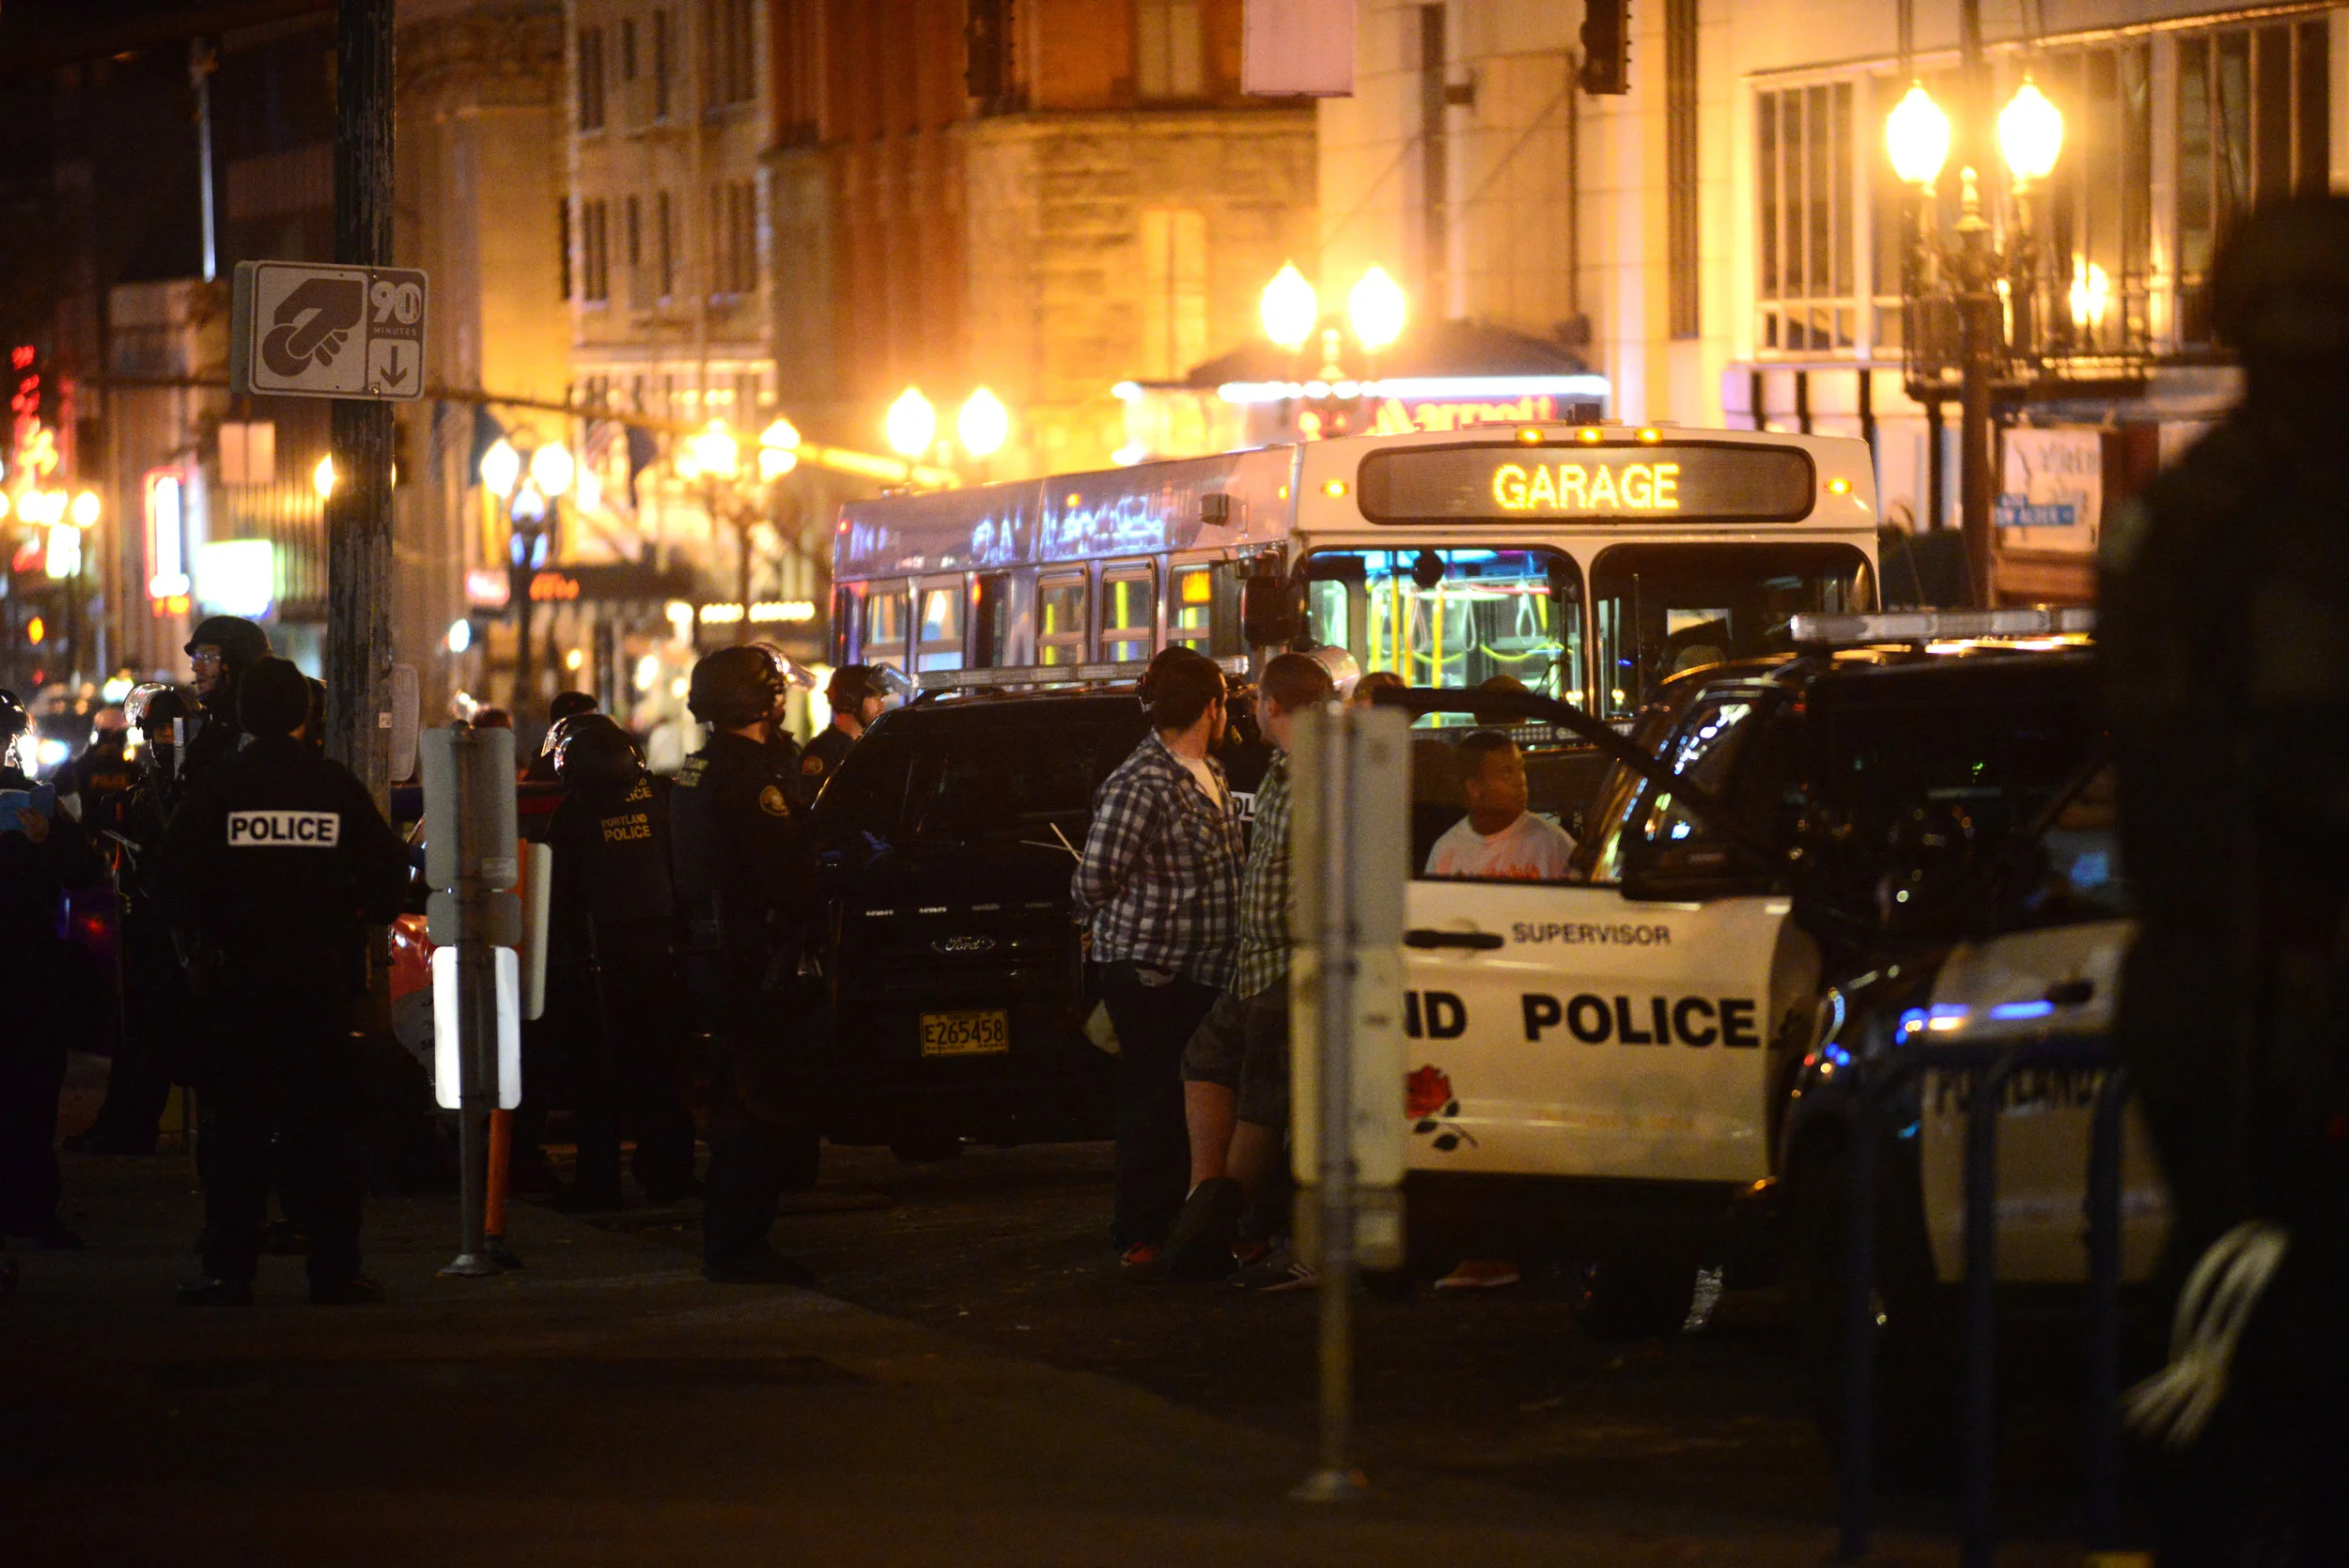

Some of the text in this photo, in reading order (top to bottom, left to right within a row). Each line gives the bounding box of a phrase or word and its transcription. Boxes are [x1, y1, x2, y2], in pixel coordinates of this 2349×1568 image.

[370, 281, 422, 325] 90
[373, 327, 418, 336] MINUTES
[1493, 462, 1680, 510] GARAGE
[625, 786, 653, 801] ICE
[231, 815, 334, 842] POLICE
[600, 814, 647, 827] PORTLAND
[604, 826, 651, 842] POLICE
[1510, 922, 1672, 946] SUPERVISOR
[925, 1019, 1003, 1045] E265458
[1520, 992, 1761, 1049] POLICE
